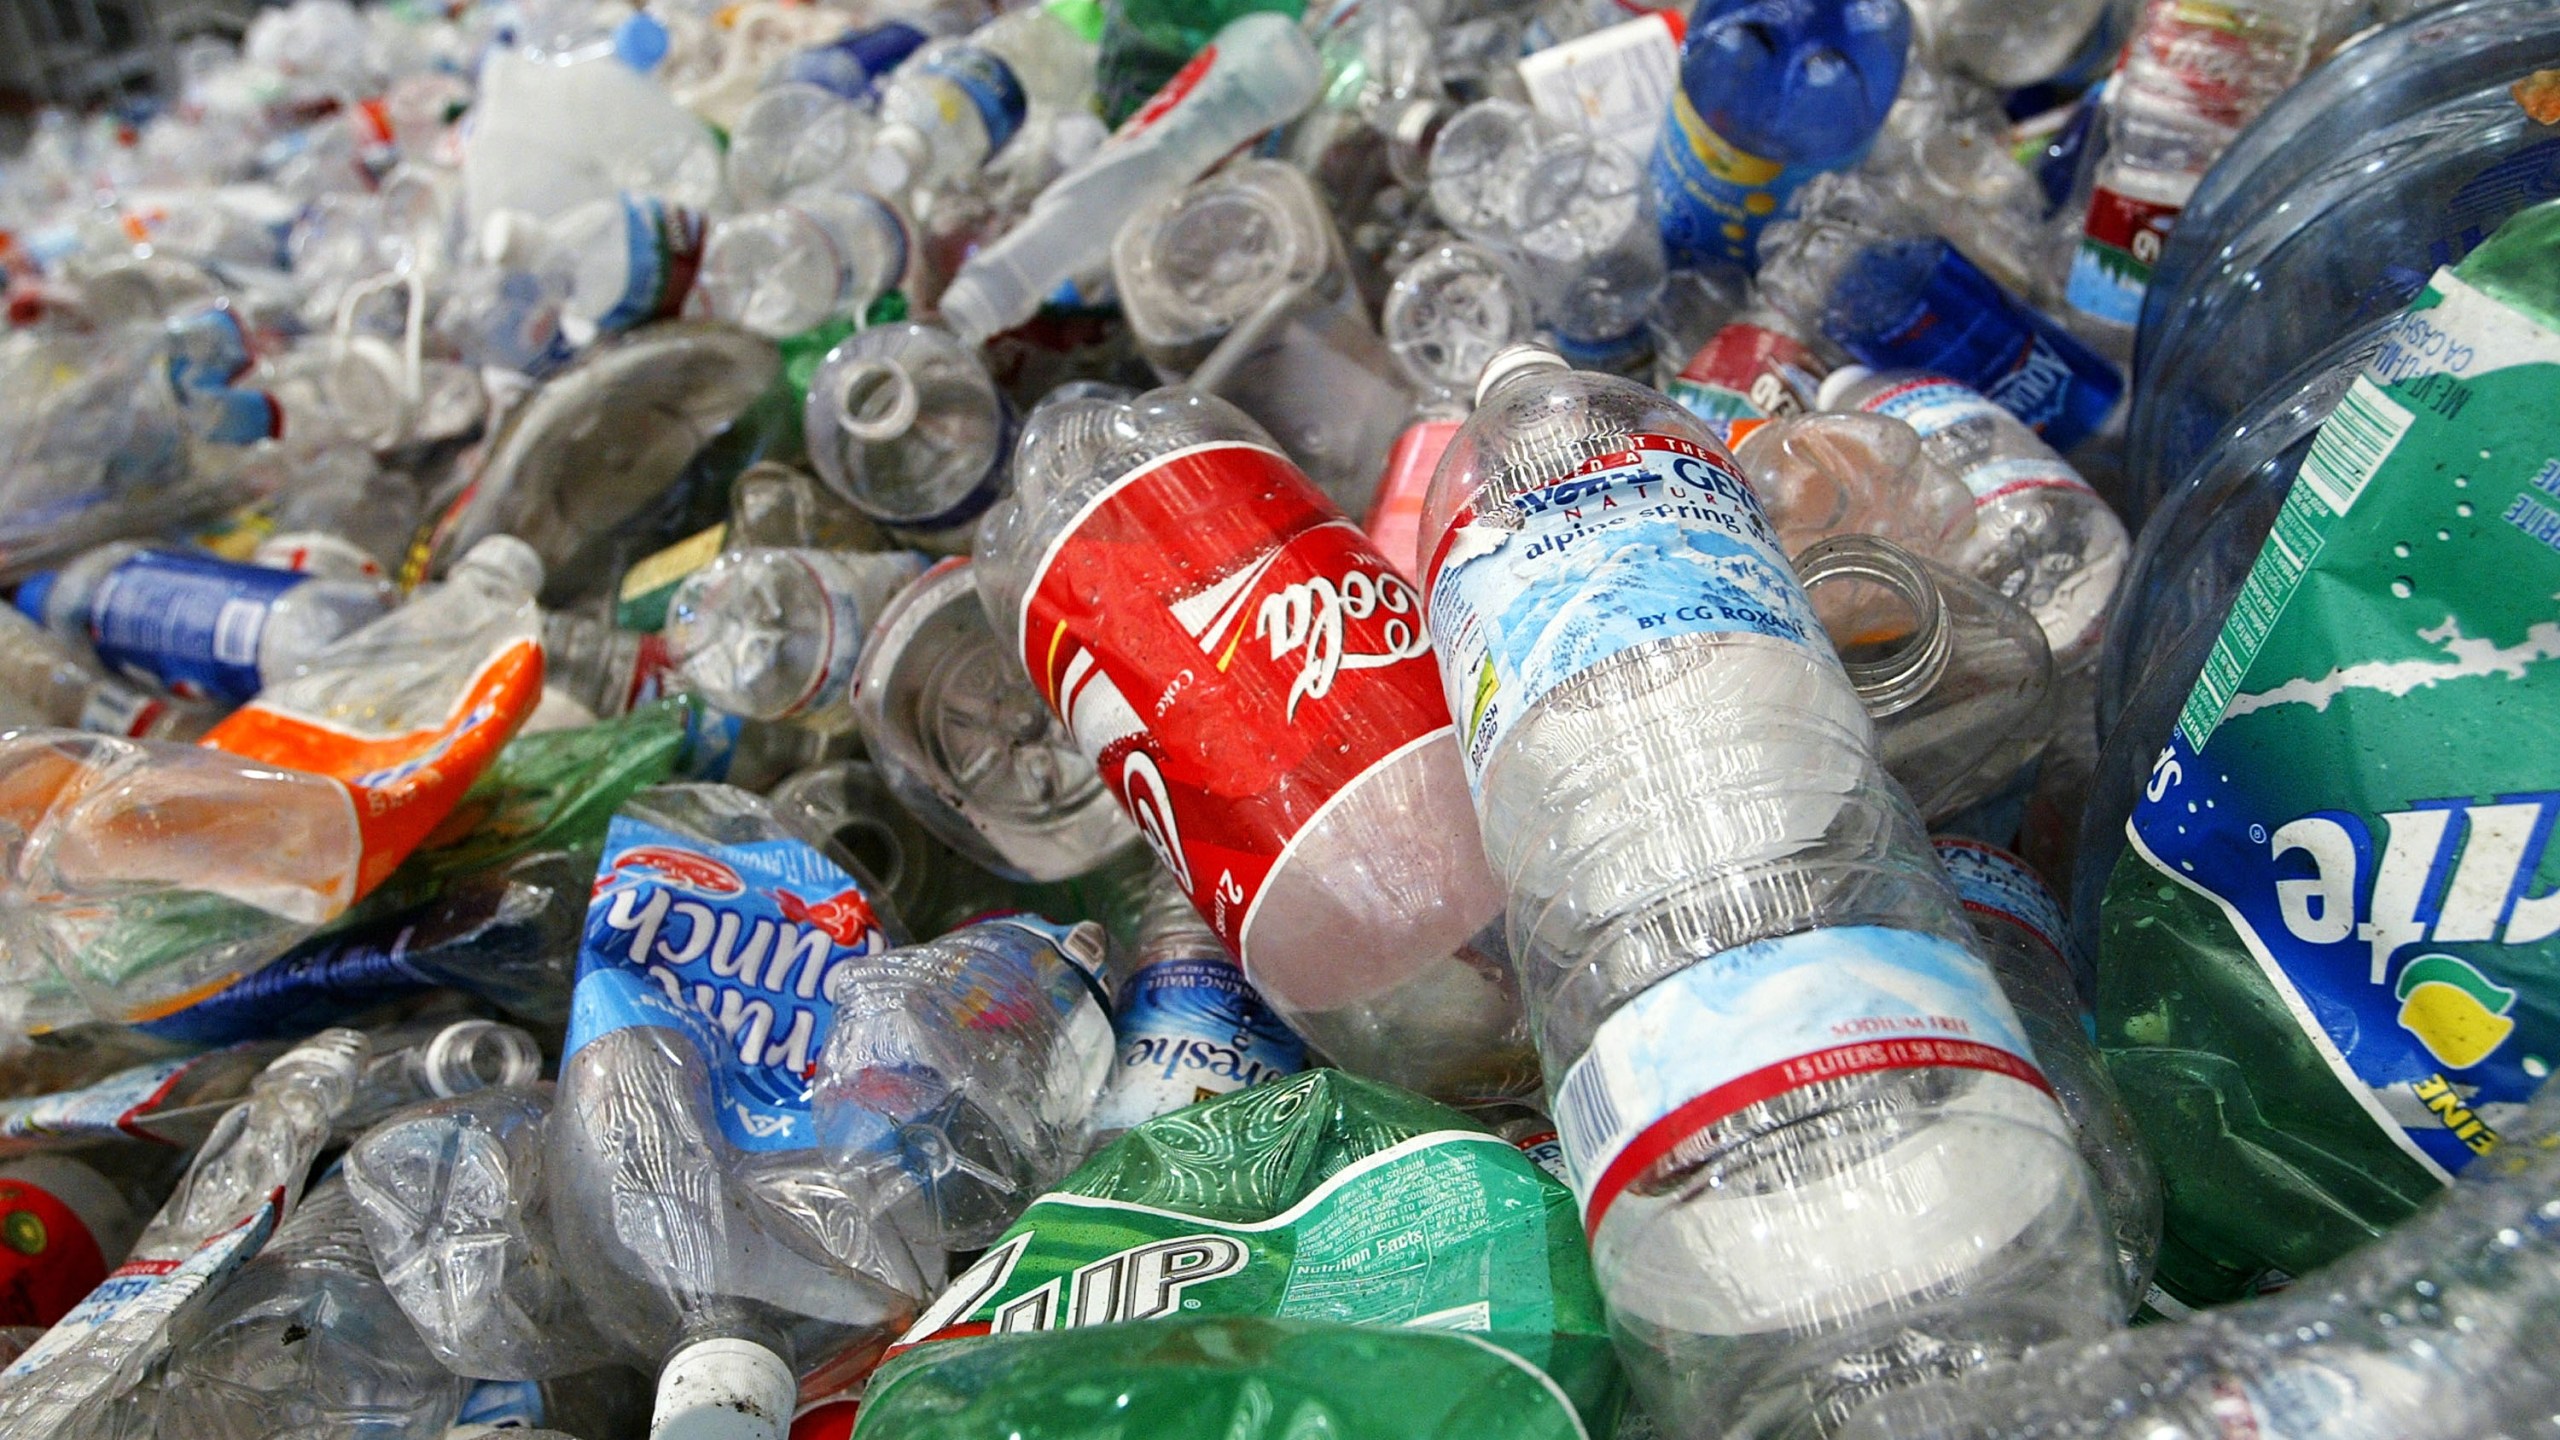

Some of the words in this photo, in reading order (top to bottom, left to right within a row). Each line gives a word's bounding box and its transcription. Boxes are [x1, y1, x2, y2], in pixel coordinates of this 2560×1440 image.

[2442, 339, 2474, 372] CA
[1665, 438, 1708, 460] THE
[1640, 501, 1742, 536] spring
[1638, 613, 1668, 631] BY
[1677, 605, 1713, 622] CG
[1722, 607, 1809, 641] ROXANE
[1155, 669, 1194, 718] Coke
[1219, 868, 1243, 905] 2
[1814, 1043, 1889, 1074] LITERS
[1297, 1247, 1371, 1275] Nutrition
[1376, 1229, 1424, 1257] Facts
